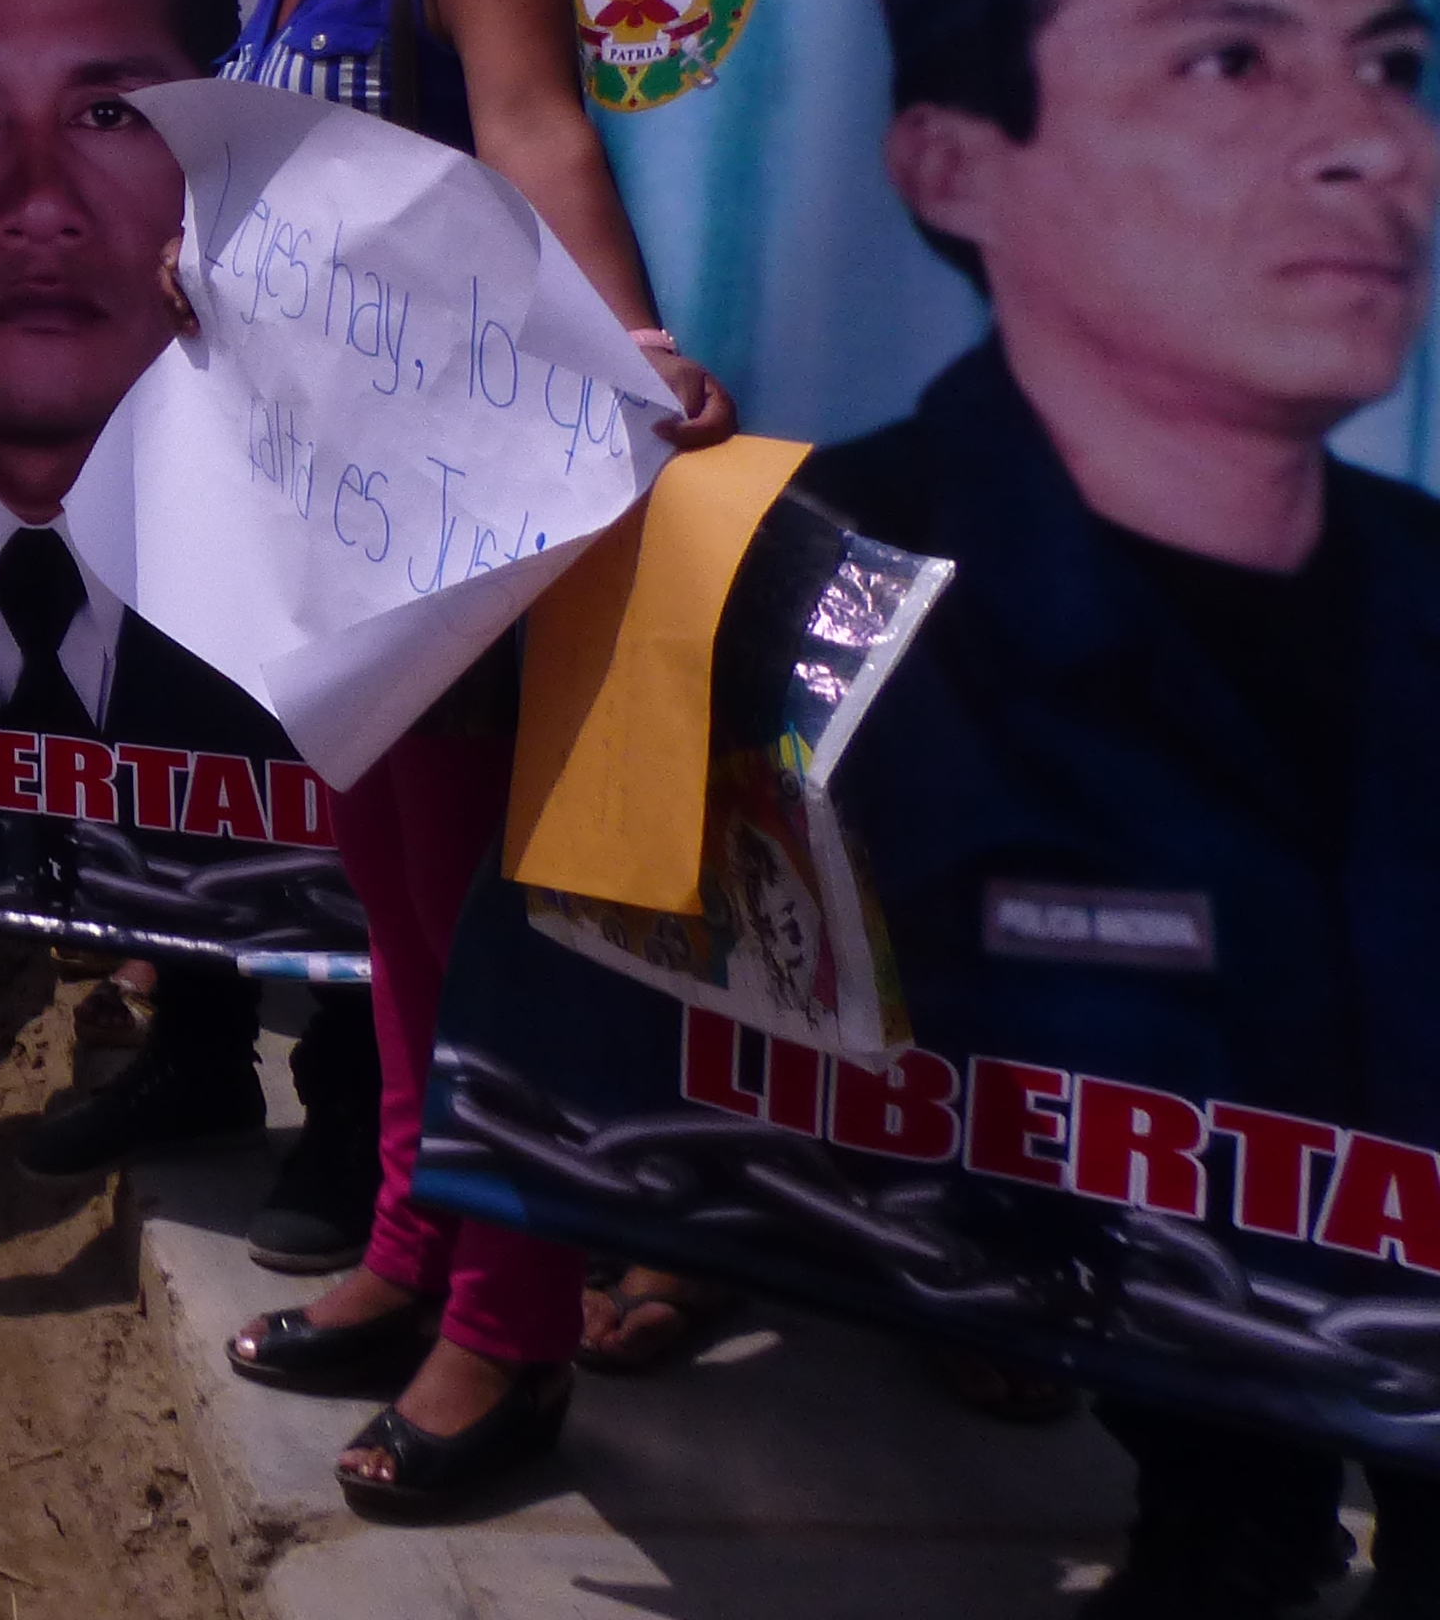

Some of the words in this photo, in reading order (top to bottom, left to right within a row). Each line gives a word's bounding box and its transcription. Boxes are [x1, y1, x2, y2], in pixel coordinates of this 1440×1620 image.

[609, 46, 664, 61] PATRIA
[205, 142, 309, 325] Leyes
[469, 276, 517, 409] lo
[334, 463, 390, 563] es
